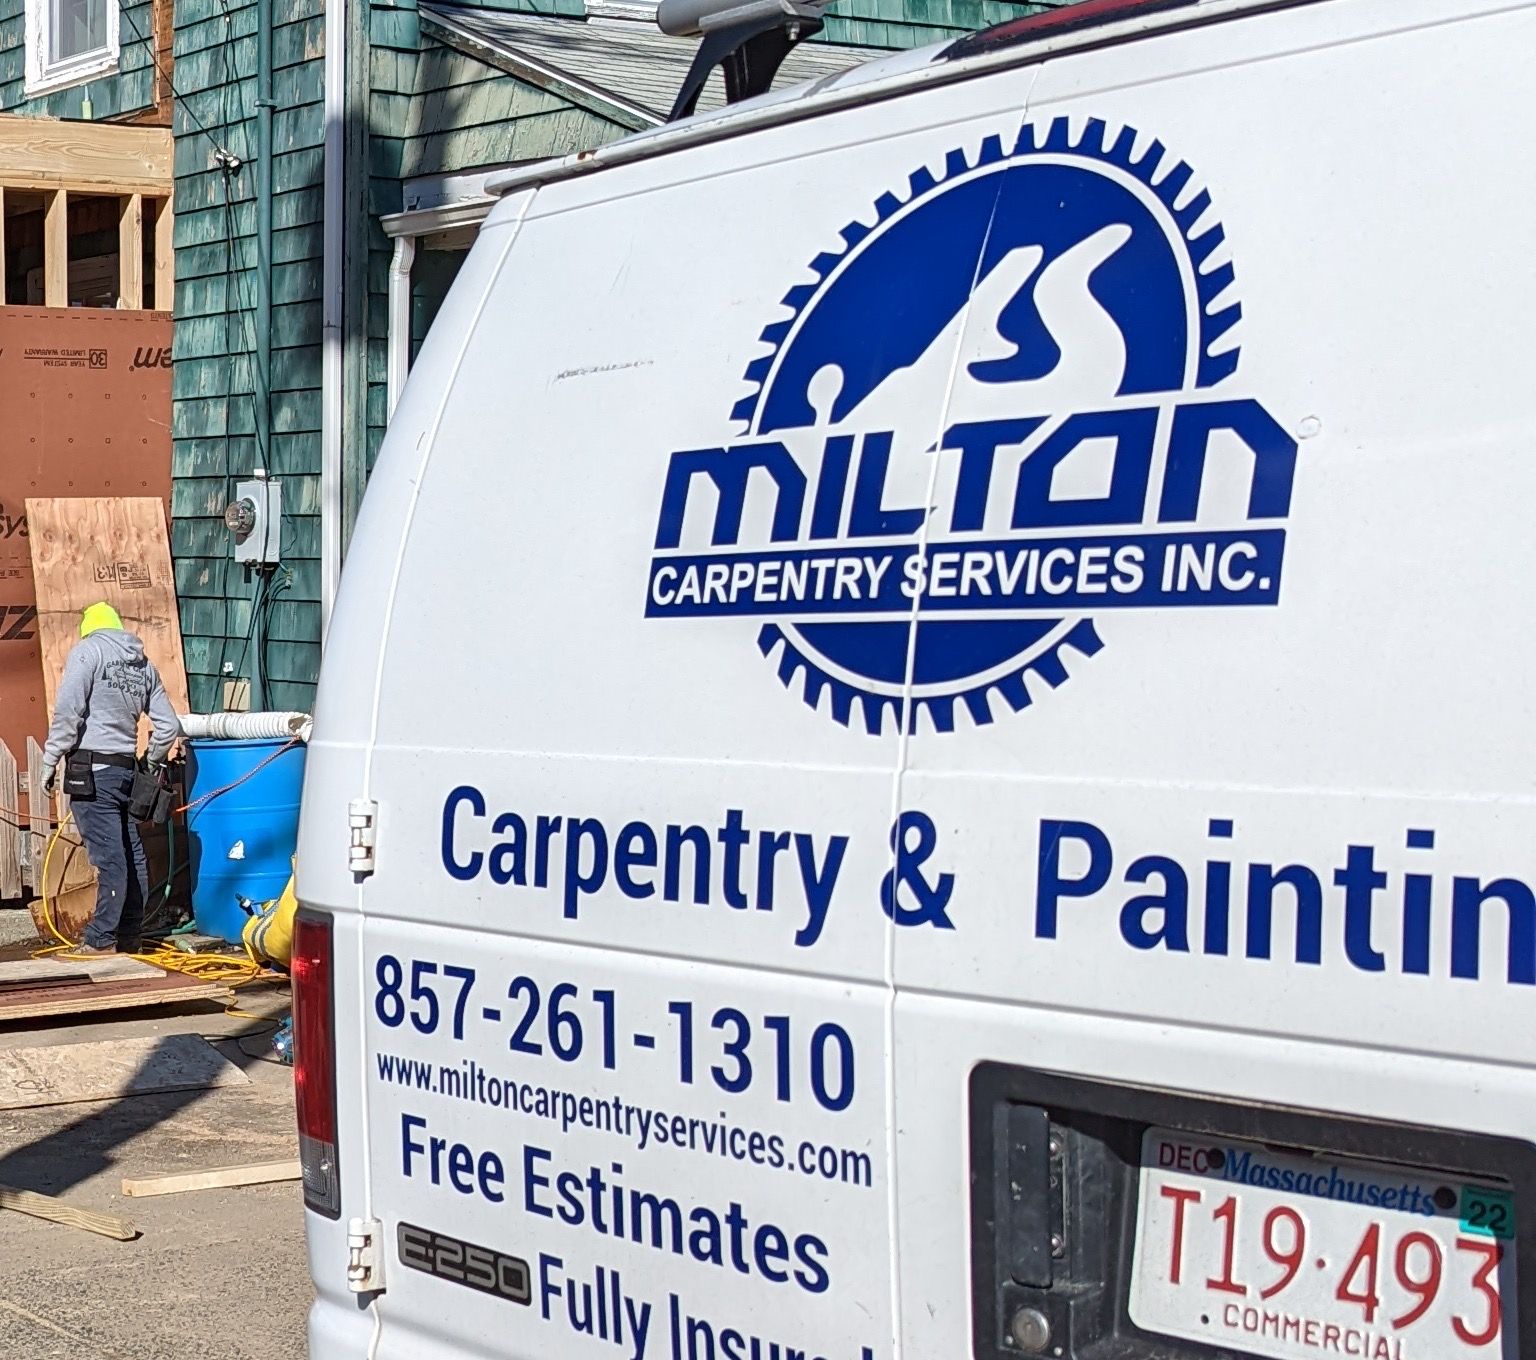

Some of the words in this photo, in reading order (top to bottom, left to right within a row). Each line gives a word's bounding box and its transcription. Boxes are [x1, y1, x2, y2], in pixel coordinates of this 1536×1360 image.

[654, 397, 1298, 551] MILTON
[651, 555, 893, 607] CARPENTRY
[900, 545, 1146, 599] SERVICES
[1159, 540, 1272, 593] INC.
[440, 784, 850, 948] Carpentry
[880, 809, 956, 929] &
[1034, 818, 1536, 987] Paintin
[374, 952, 856, 1113] 857-261-1310
[376, 1049, 872, 1188] www.miltoncarpentryservices.com
[1158, 1141, 1209, 1174] DEC
[1222, 1147, 1438, 1218] Massachusetts
[400, 1113, 506, 1203] Free
[522, 1145, 830, 1295] Estimates
[1468, 1199, 1508, 1233] 22
